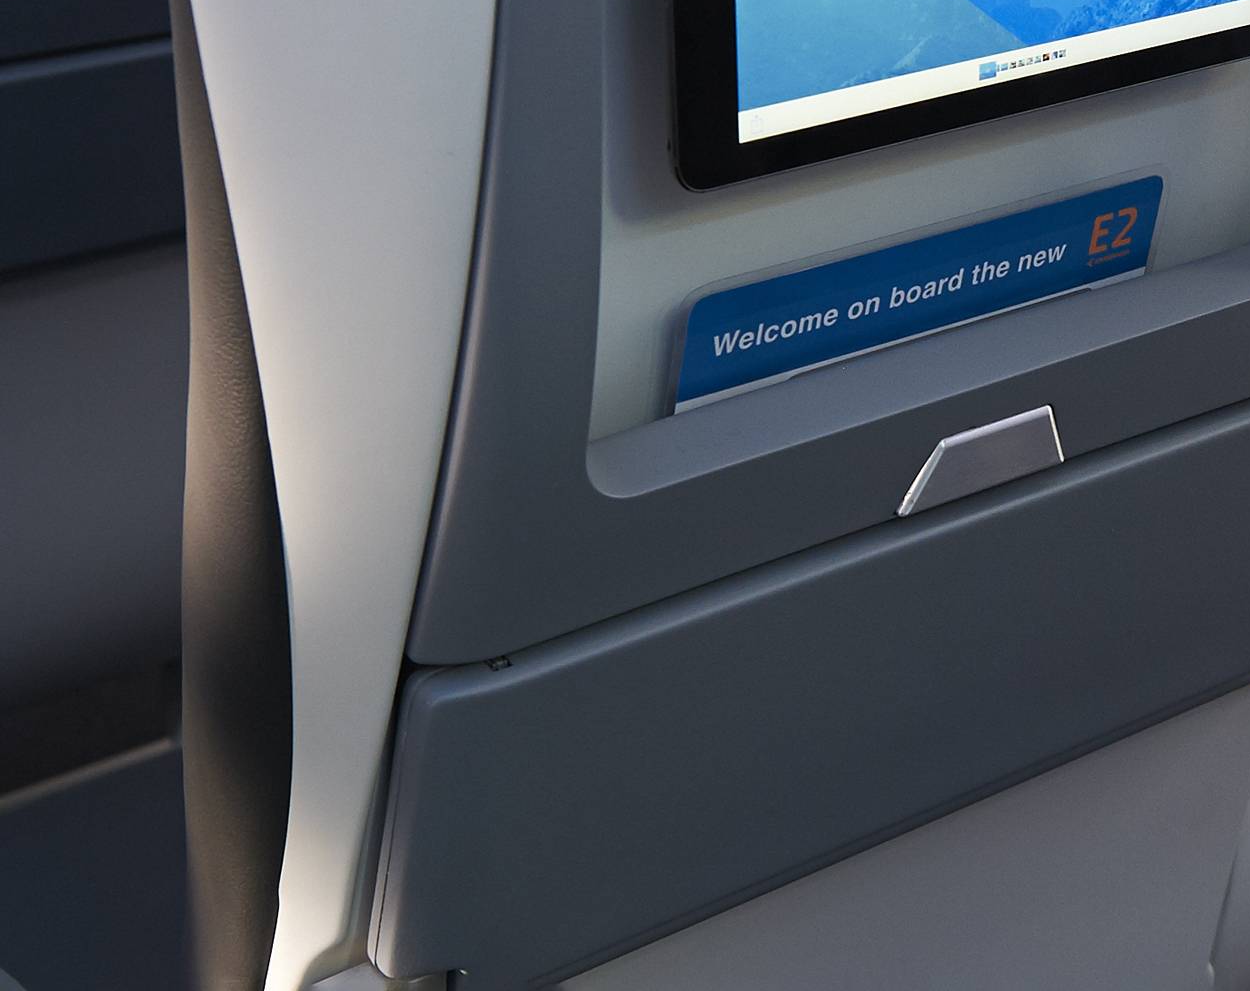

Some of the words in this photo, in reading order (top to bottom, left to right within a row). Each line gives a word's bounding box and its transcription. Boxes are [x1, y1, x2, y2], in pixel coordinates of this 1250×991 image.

[1088, 206, 1138, 256] E2
[713, 308, 839, 357] Welcome
[847, 295, 881, 320] on
[888, 269, 964, 309] board
[971, 257, 1011, 285] the
[1017, 242, 1067, 273] new
